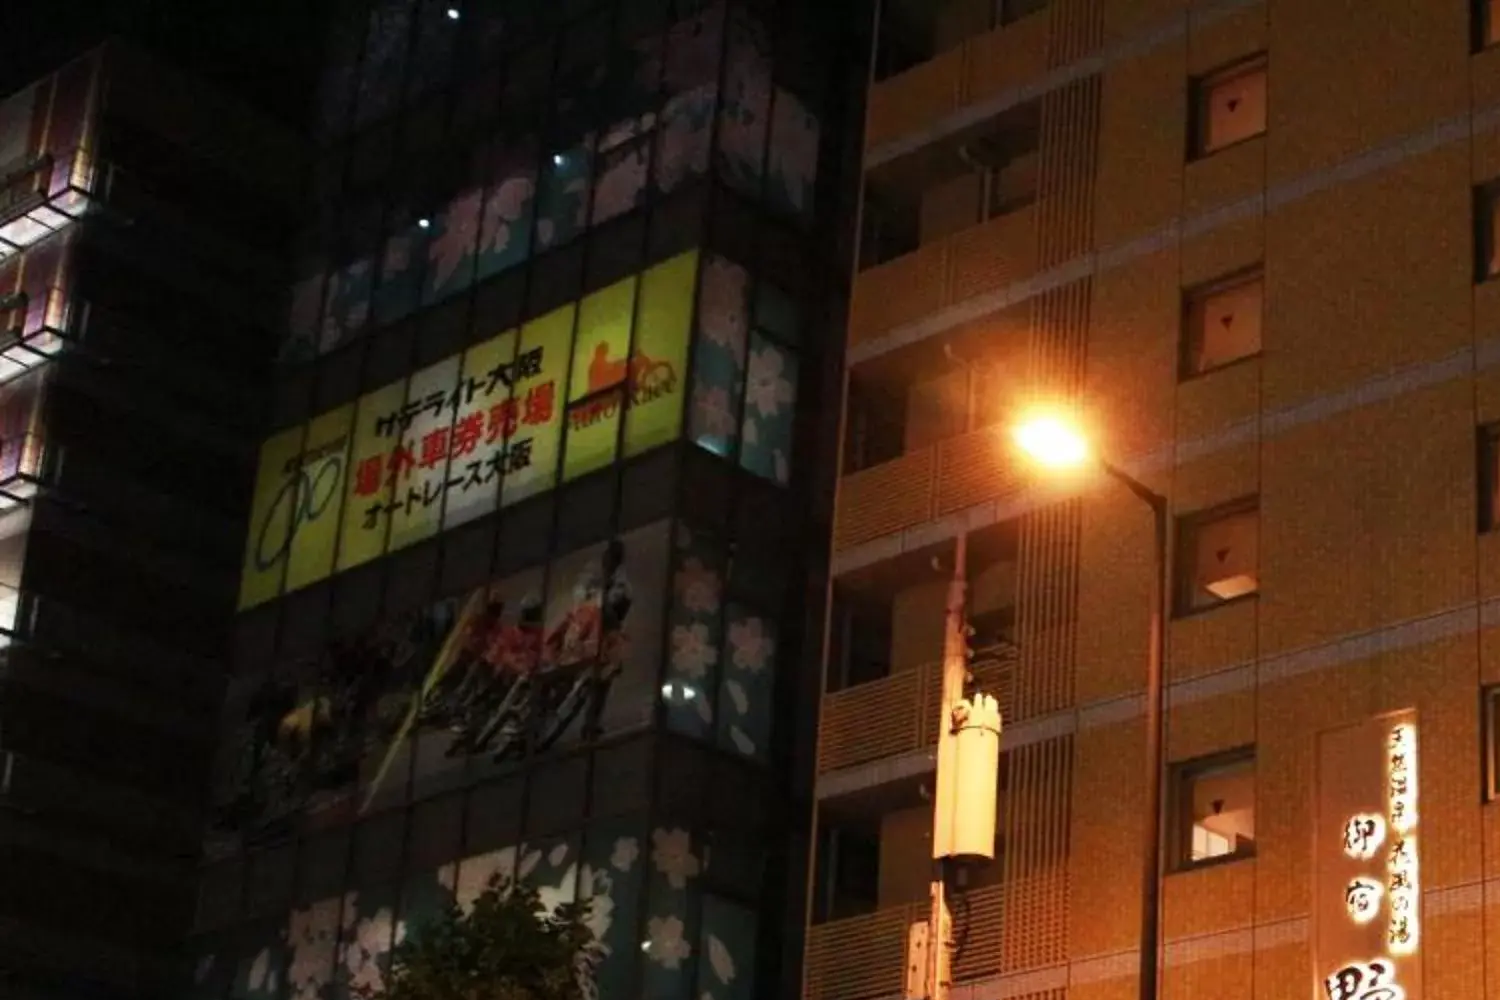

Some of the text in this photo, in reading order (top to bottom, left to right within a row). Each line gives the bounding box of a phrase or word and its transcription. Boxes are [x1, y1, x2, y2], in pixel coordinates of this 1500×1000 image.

[355, 380, 555, 496] 場外車券売場
[376, 347, 543, 438] サテライト大阪
[362, 438, 533, 529] オートレース大阪
